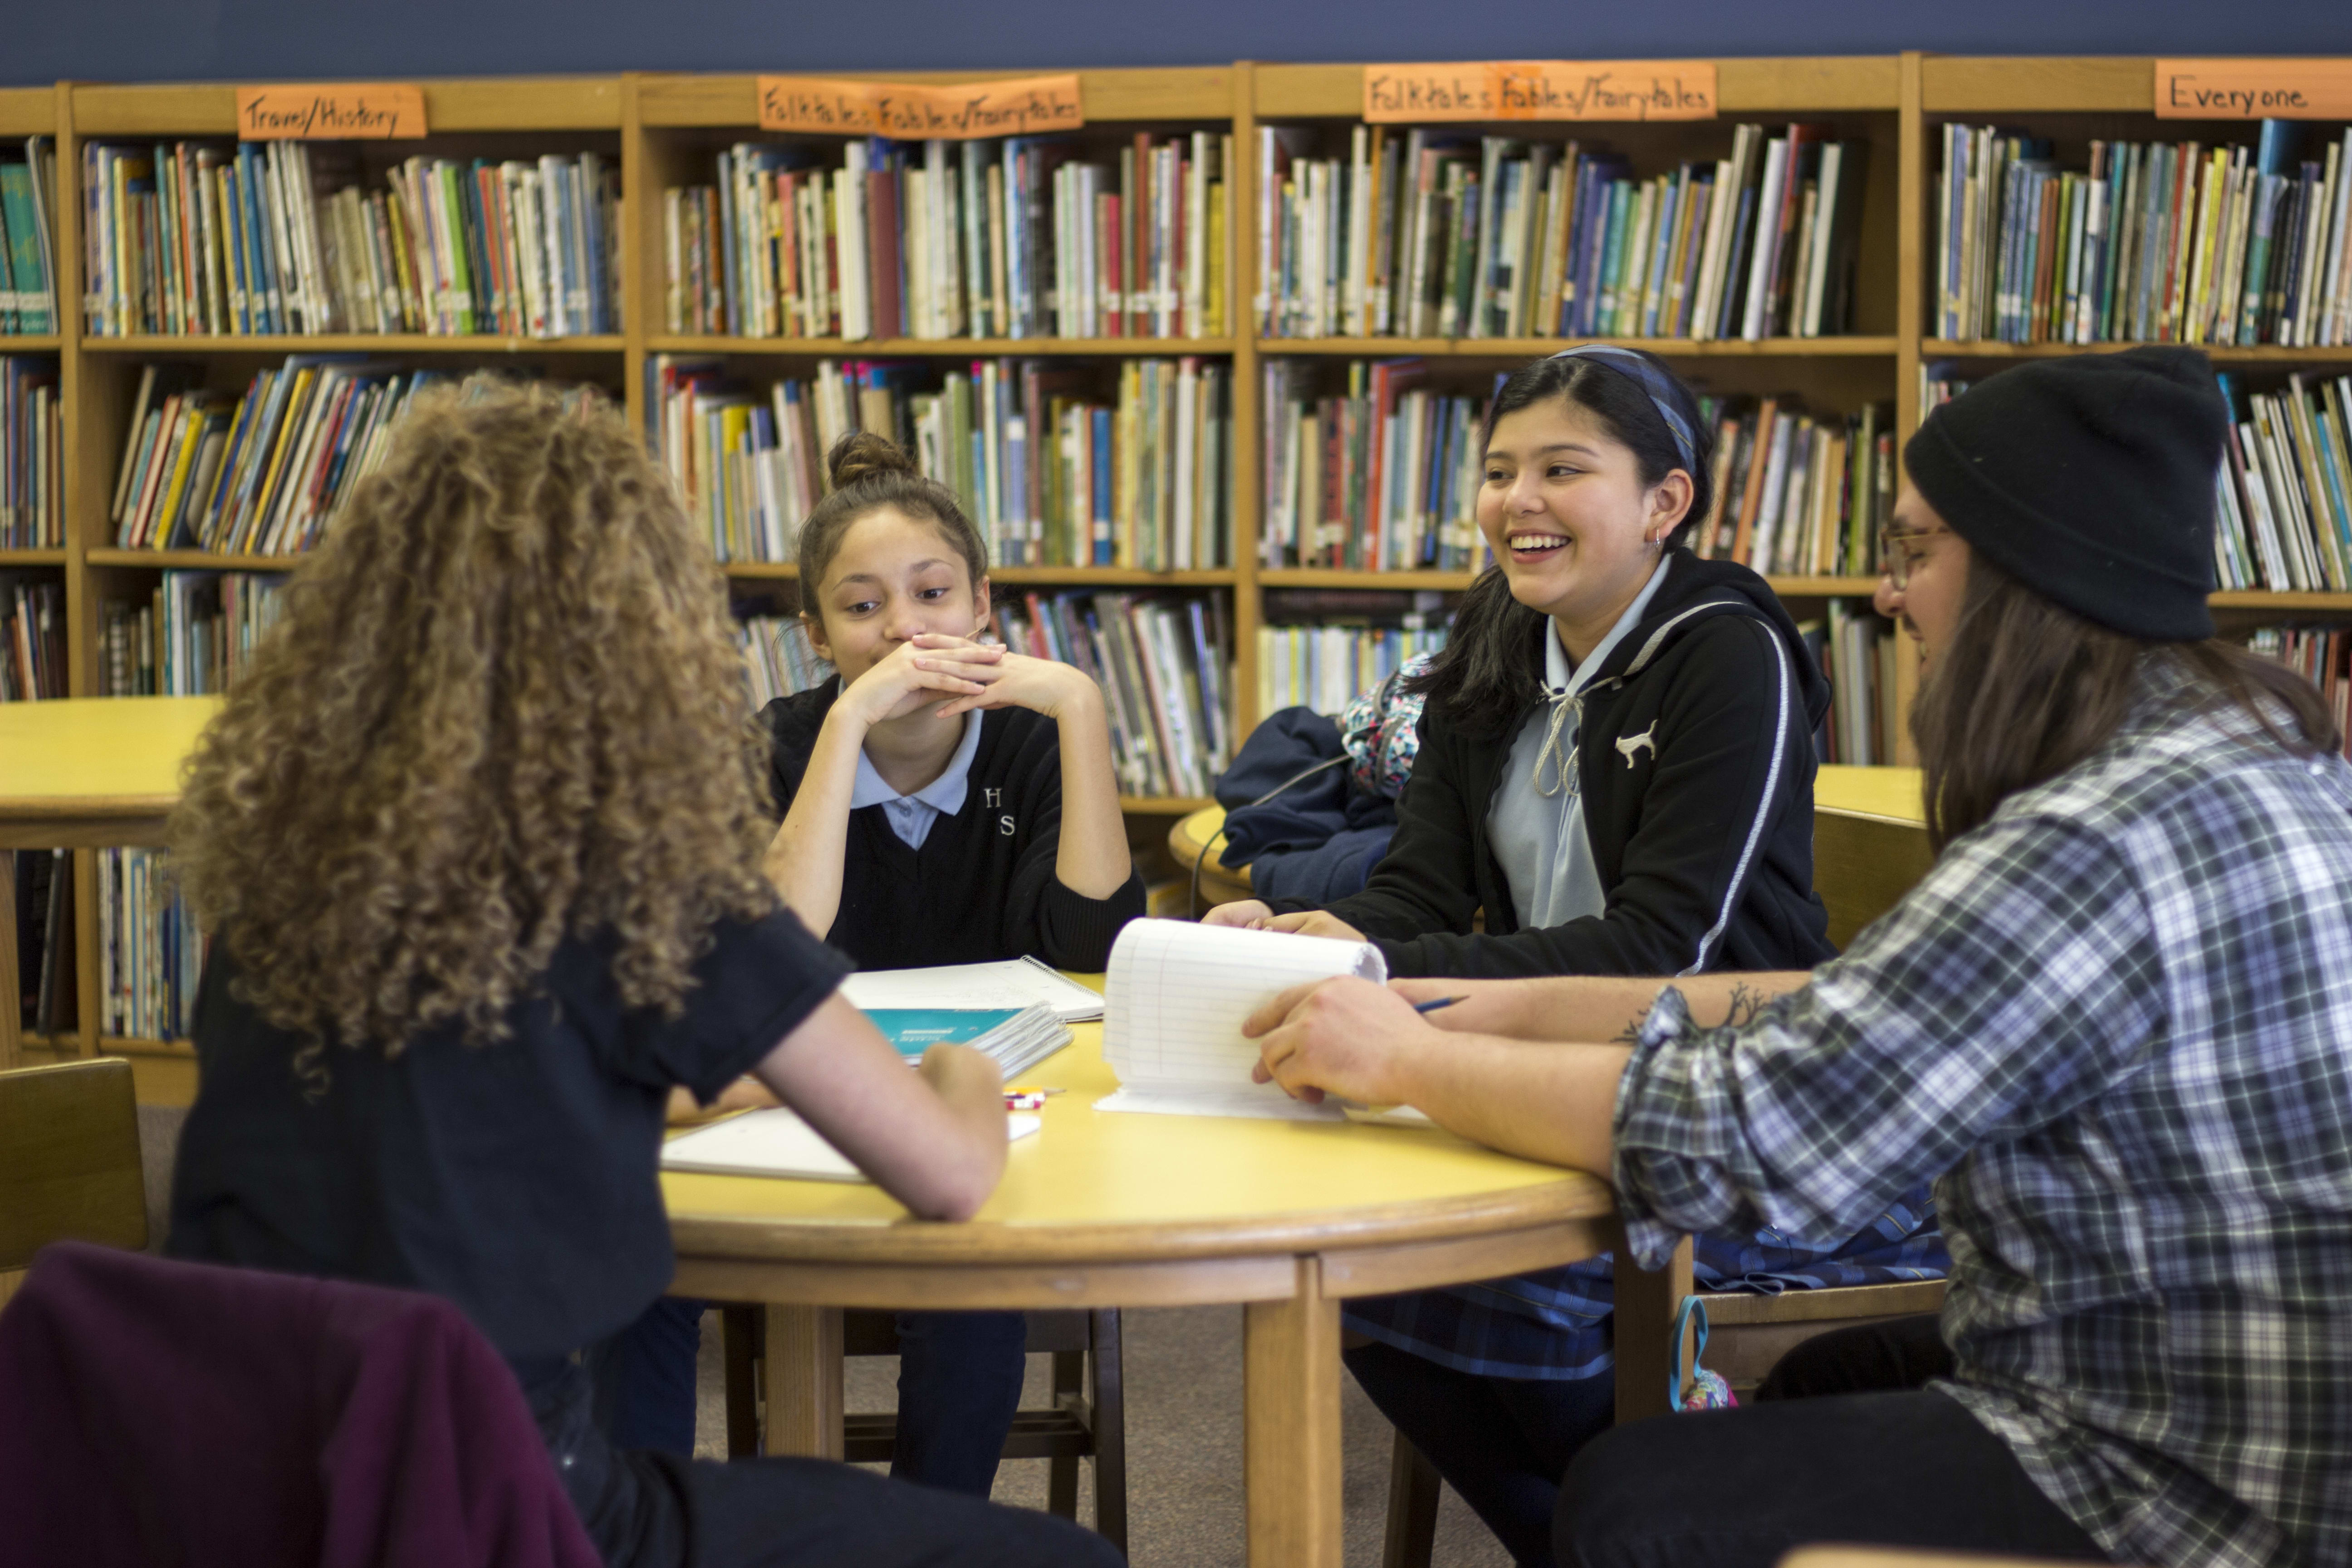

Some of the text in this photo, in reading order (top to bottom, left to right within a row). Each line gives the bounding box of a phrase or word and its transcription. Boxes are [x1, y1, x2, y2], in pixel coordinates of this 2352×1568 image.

[764, 85, 872, 127] Folktales
[1369, 73, 1493, 112] Folktales
[2170, 74, 2309, 116] Everyone
[245, 94, 399, 139] Travel/History
[983, 788, 1002, 808] H
[1000, 815, 1015, 835] S
